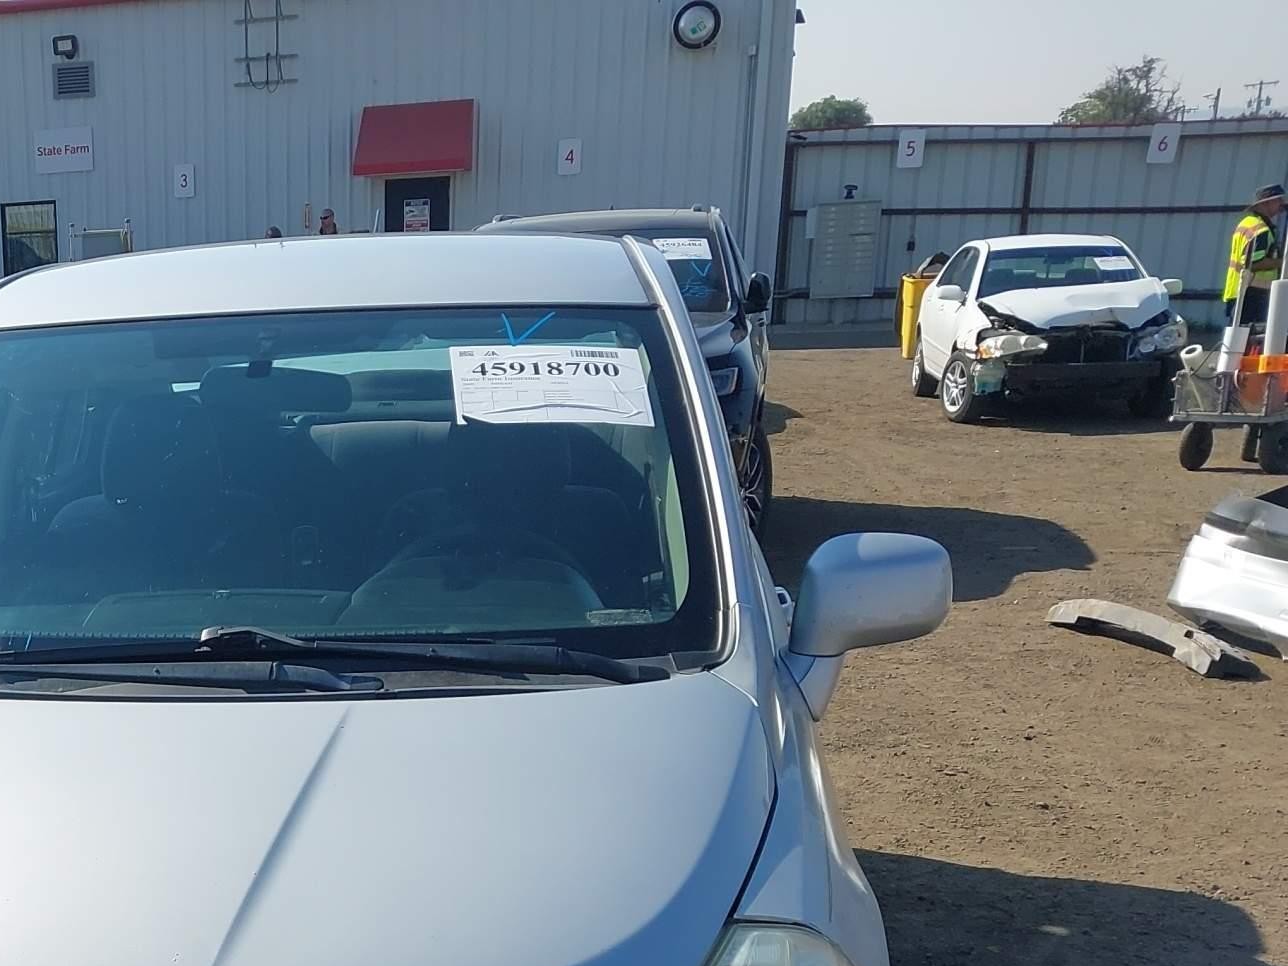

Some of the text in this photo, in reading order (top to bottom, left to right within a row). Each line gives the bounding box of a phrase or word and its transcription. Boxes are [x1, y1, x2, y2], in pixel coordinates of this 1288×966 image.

[37, 144, 90, 157] State Farm
[906, 140, 916, 156] 5
[1157, 136, 1169, 152] 6
[564, 149, 575, 164] 4
[180, 173, 188, 188] 3
[472, 361, 620, 377] 45918700
